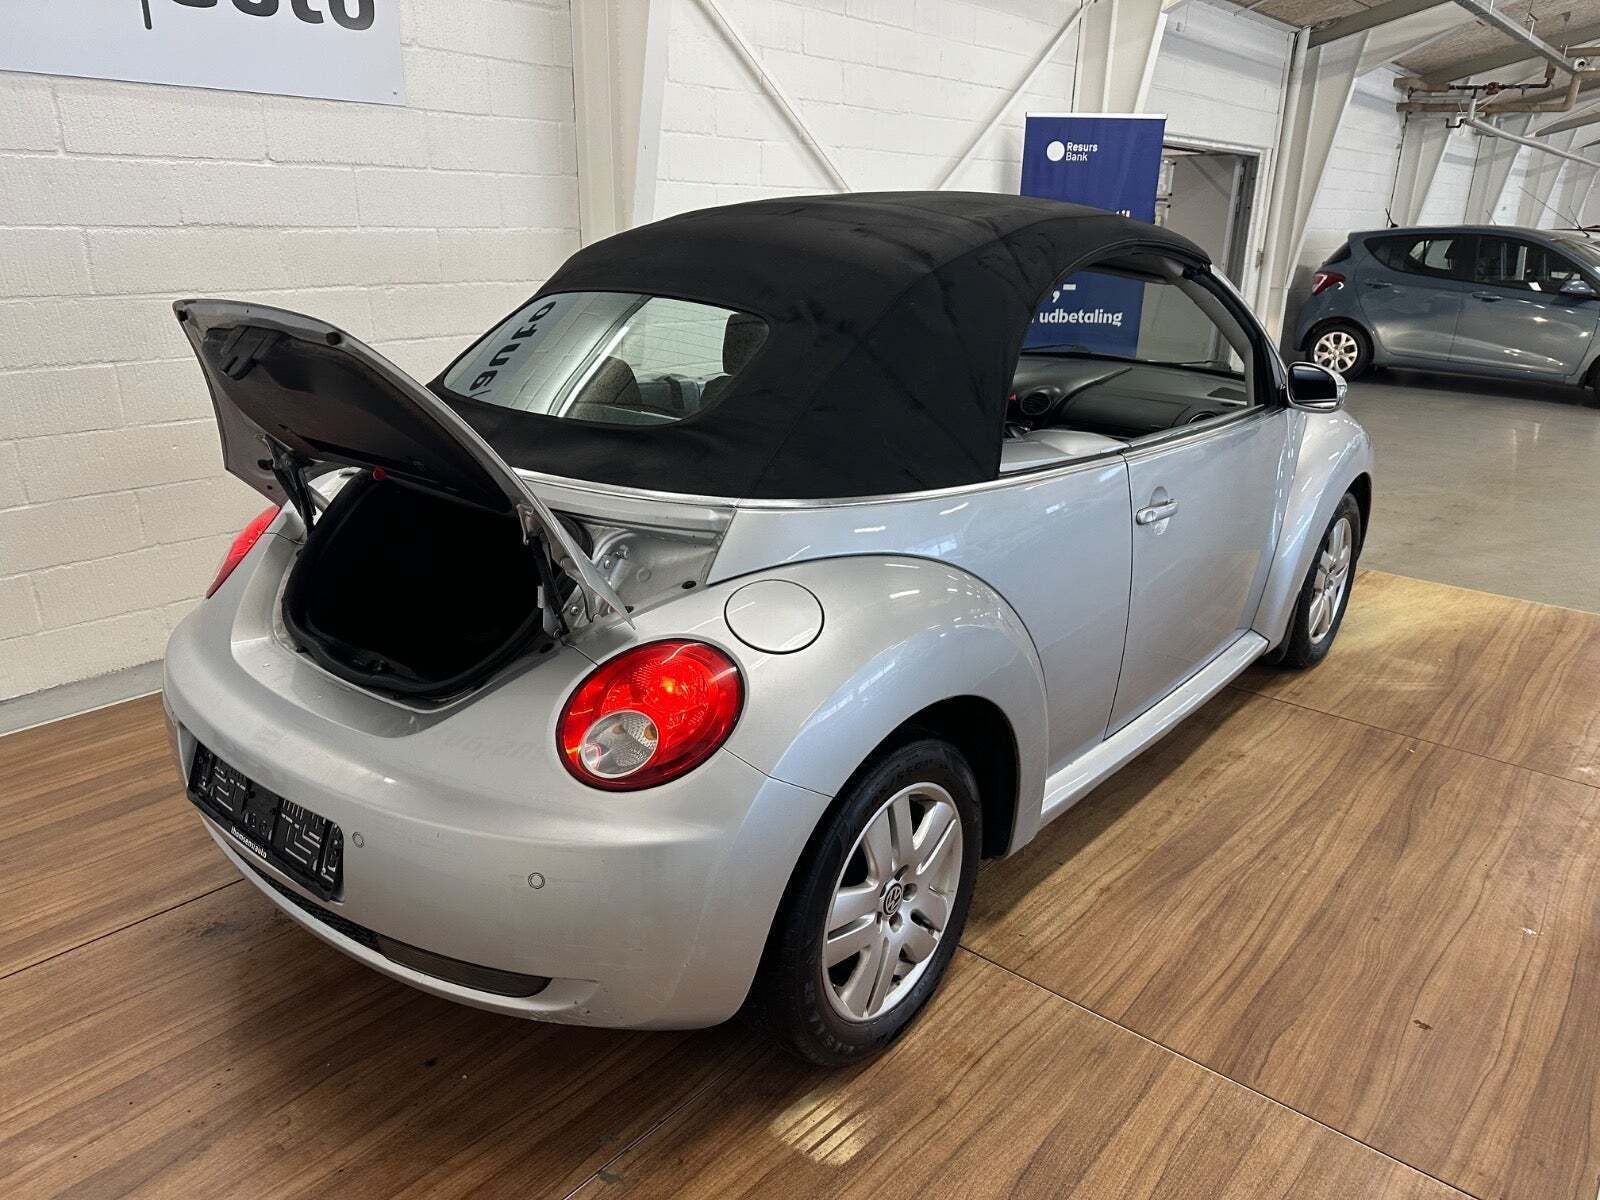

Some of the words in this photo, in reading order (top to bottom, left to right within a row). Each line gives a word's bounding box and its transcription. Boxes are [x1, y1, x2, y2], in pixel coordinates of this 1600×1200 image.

[1067, 141, 1098, 153] Resurs
[1065, 152, 1088, 162] Bank
[1039, 309, 1123, 327] udbetaling
